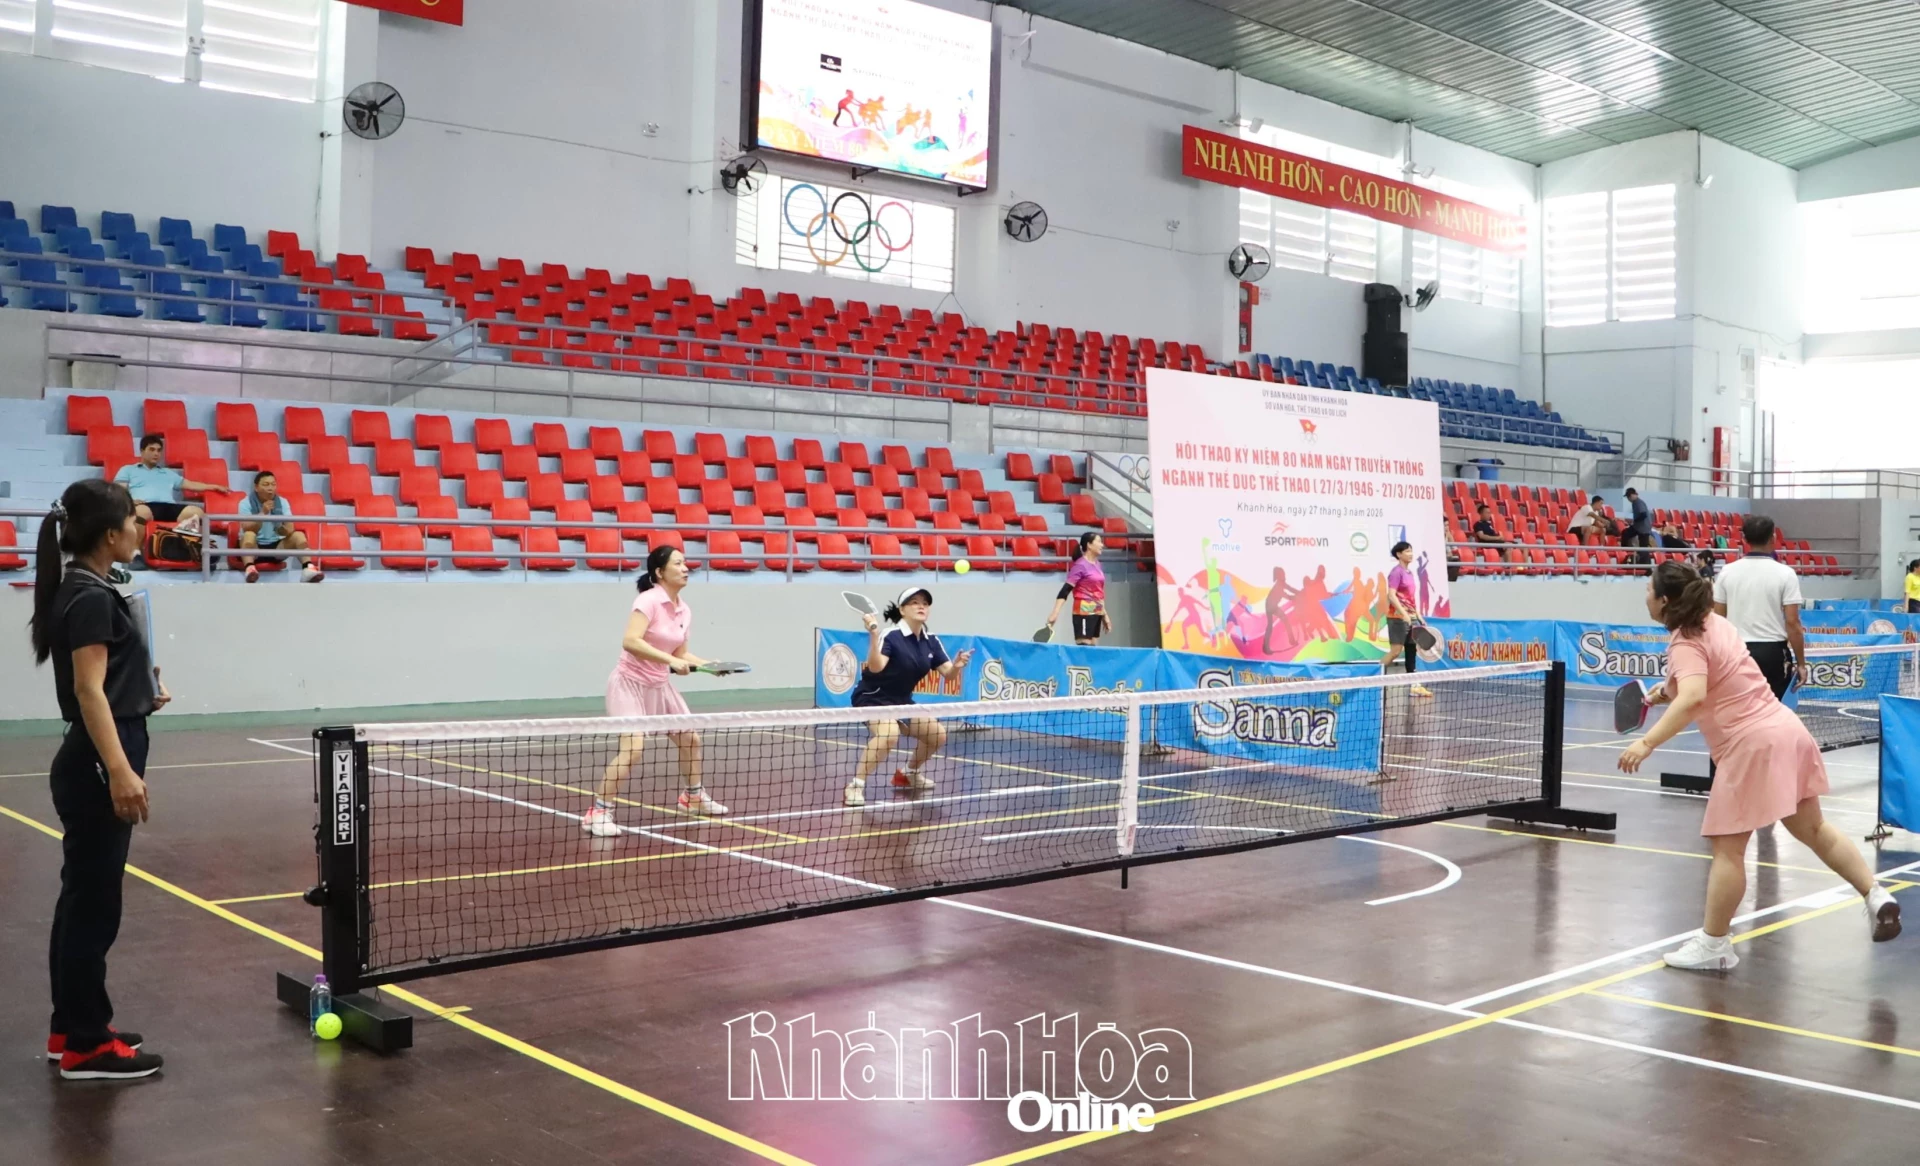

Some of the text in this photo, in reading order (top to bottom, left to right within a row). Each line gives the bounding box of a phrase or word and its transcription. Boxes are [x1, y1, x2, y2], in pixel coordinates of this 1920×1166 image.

[1194, 137, 1273, 184] NHANH
[1280, 159, 1324, 195] HƠN
[1340, 174, 1379, 208] CAO
[1384, 185, 1422, 217] HƠN
[1435, 199, 1484, 237] MẠNH
[1176, 440, 1197, 463] HỘI
[1201, 444, 1231, 463] THAO
[1252, 447, 1280, 468] NIỆM
[1283, 451, 1297, 467] 80
[1208, 468, 1230, 489] THỂ
[1233, 473, 1256, 493] DỤC
[1259, 470, 1280, 492] THỂ
[1282, 476, 1310, 494] THAO
[1320, 478, 1374, 497] 27/3/1946
[1309, 505, 1318, 515] 27
[1343, 507, 1348, 517] 3
[1212, 543, 1241, 552] motive
[1447, 632, 1547, 662] YẾN SÀO KHÁNH HÒA
[980, 658, 1057, 702] Sanest
[1193, 666, 1337, 749] Sanna
